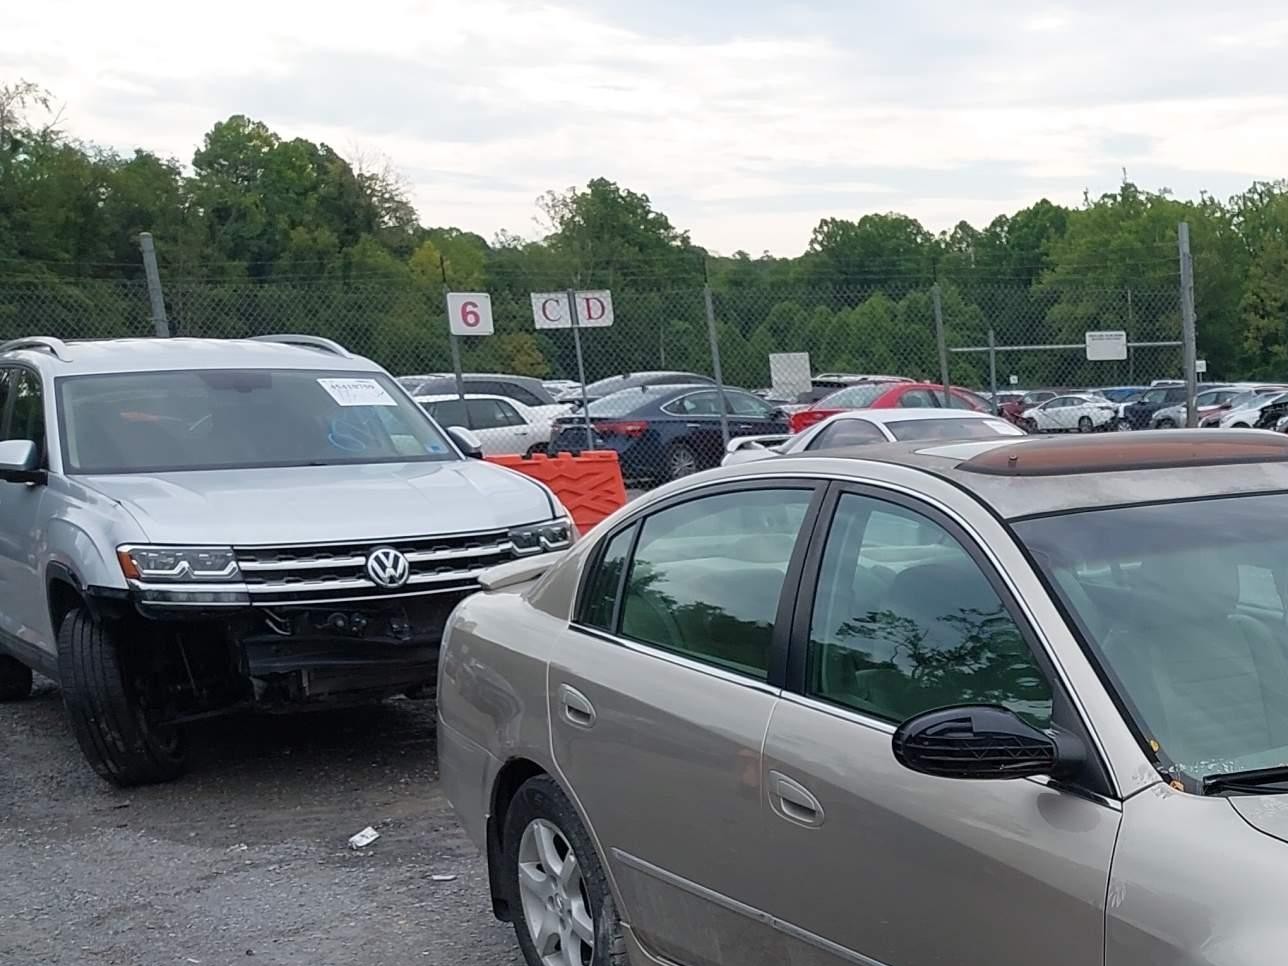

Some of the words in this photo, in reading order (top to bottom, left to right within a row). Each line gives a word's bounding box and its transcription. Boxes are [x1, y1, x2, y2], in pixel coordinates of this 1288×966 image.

[460, 301, 481, 327] 6
[542, 299, 561, 321] C
[584, 297, 605, 320] D
